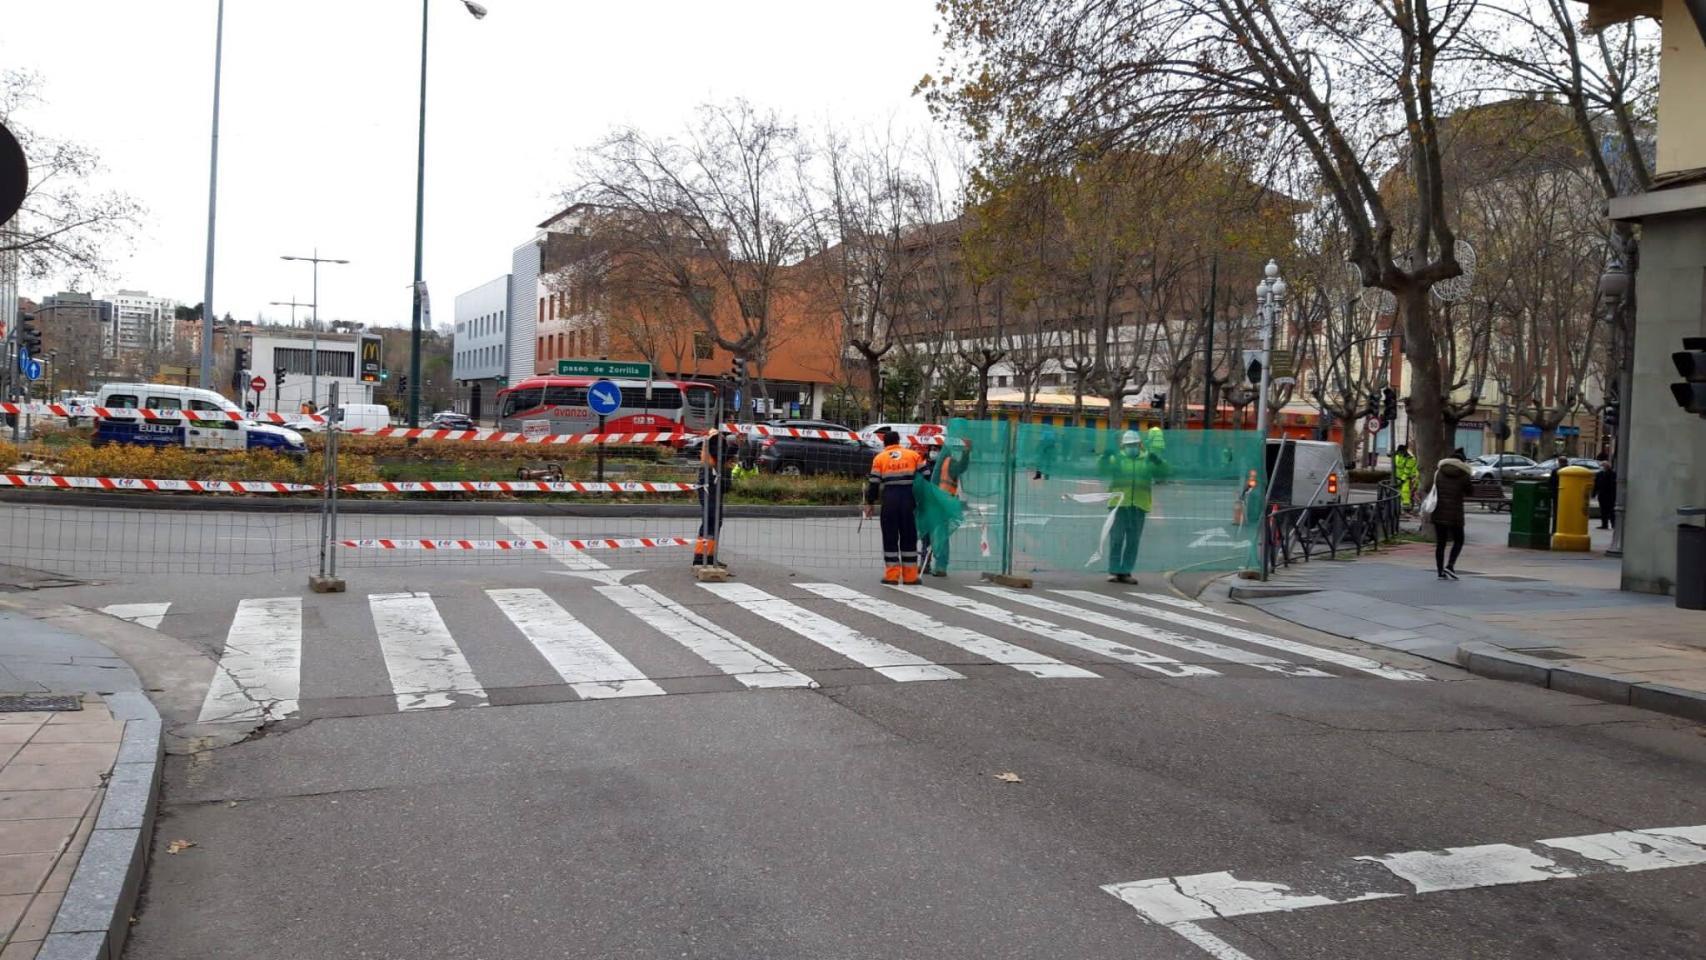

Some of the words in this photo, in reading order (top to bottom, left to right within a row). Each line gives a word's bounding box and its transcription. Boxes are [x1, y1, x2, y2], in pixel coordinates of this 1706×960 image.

[562, 365, 589, 373] paseo
[608, 366, 640, 375] Zorrilla
[553, 408, 588, 417] avanza
[139, 424, 174, 434] EULEN
